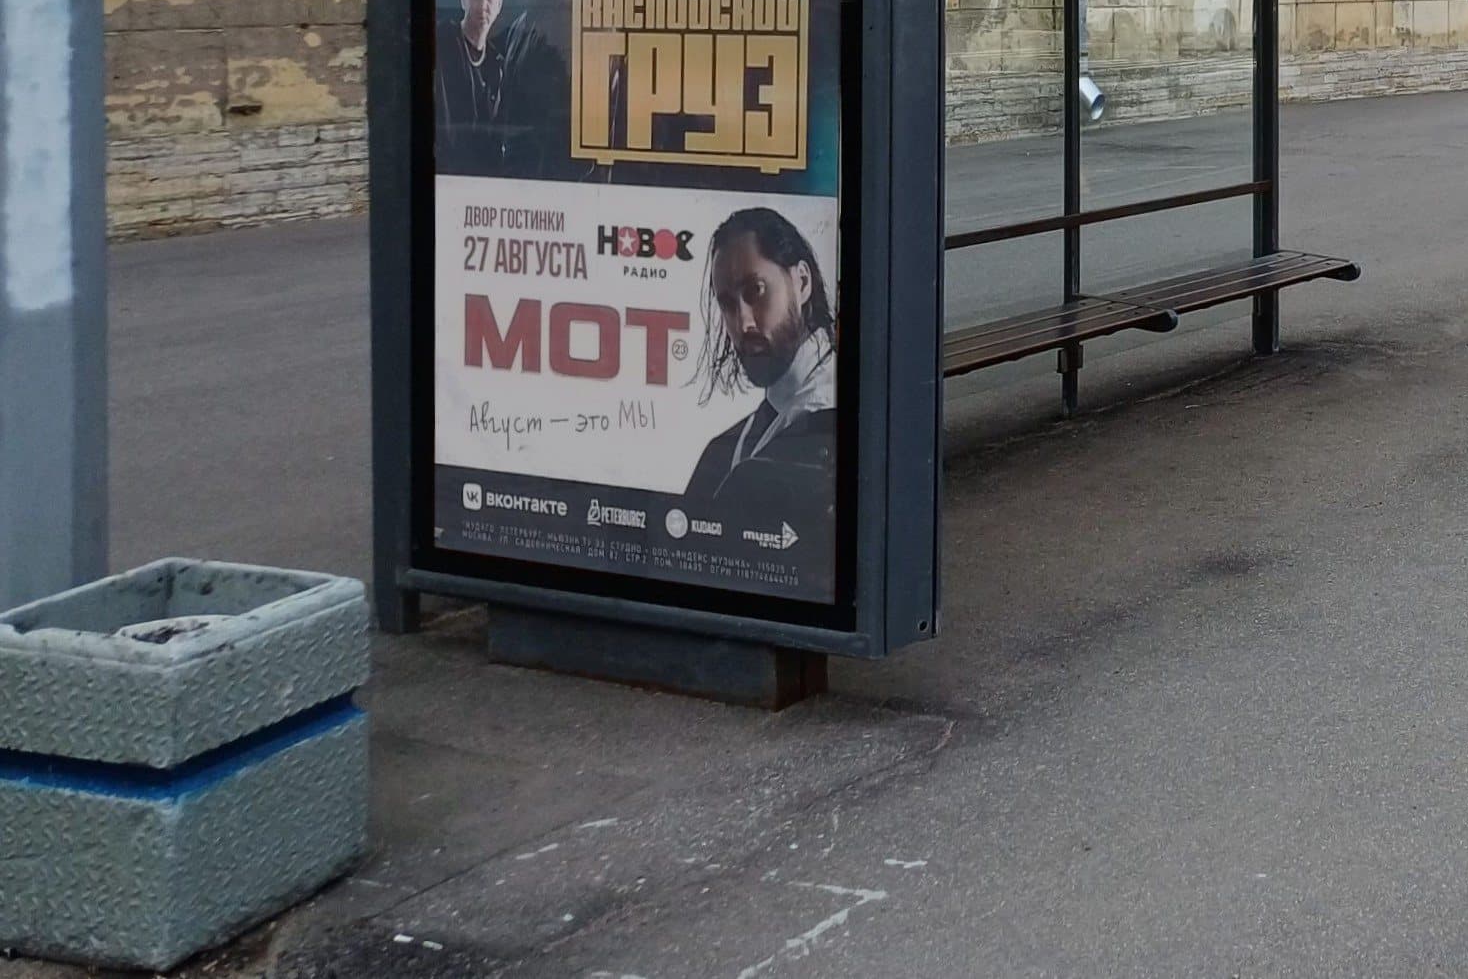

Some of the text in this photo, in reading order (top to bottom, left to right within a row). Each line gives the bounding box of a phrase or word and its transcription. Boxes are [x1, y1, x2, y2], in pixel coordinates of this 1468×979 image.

[580, 31, 799, 156] ГРУЗ
[464, 205, 565, 233] ДВОР ГОСТИНКИ
[464, 235, 588, 281] 27 АВГУСТА
[623, 265, 668, 280] РАДИО
[464, 292, 690, 387] МОТ
[468, 401, 543, 452] Август
[575, 415, 610, 434] это
